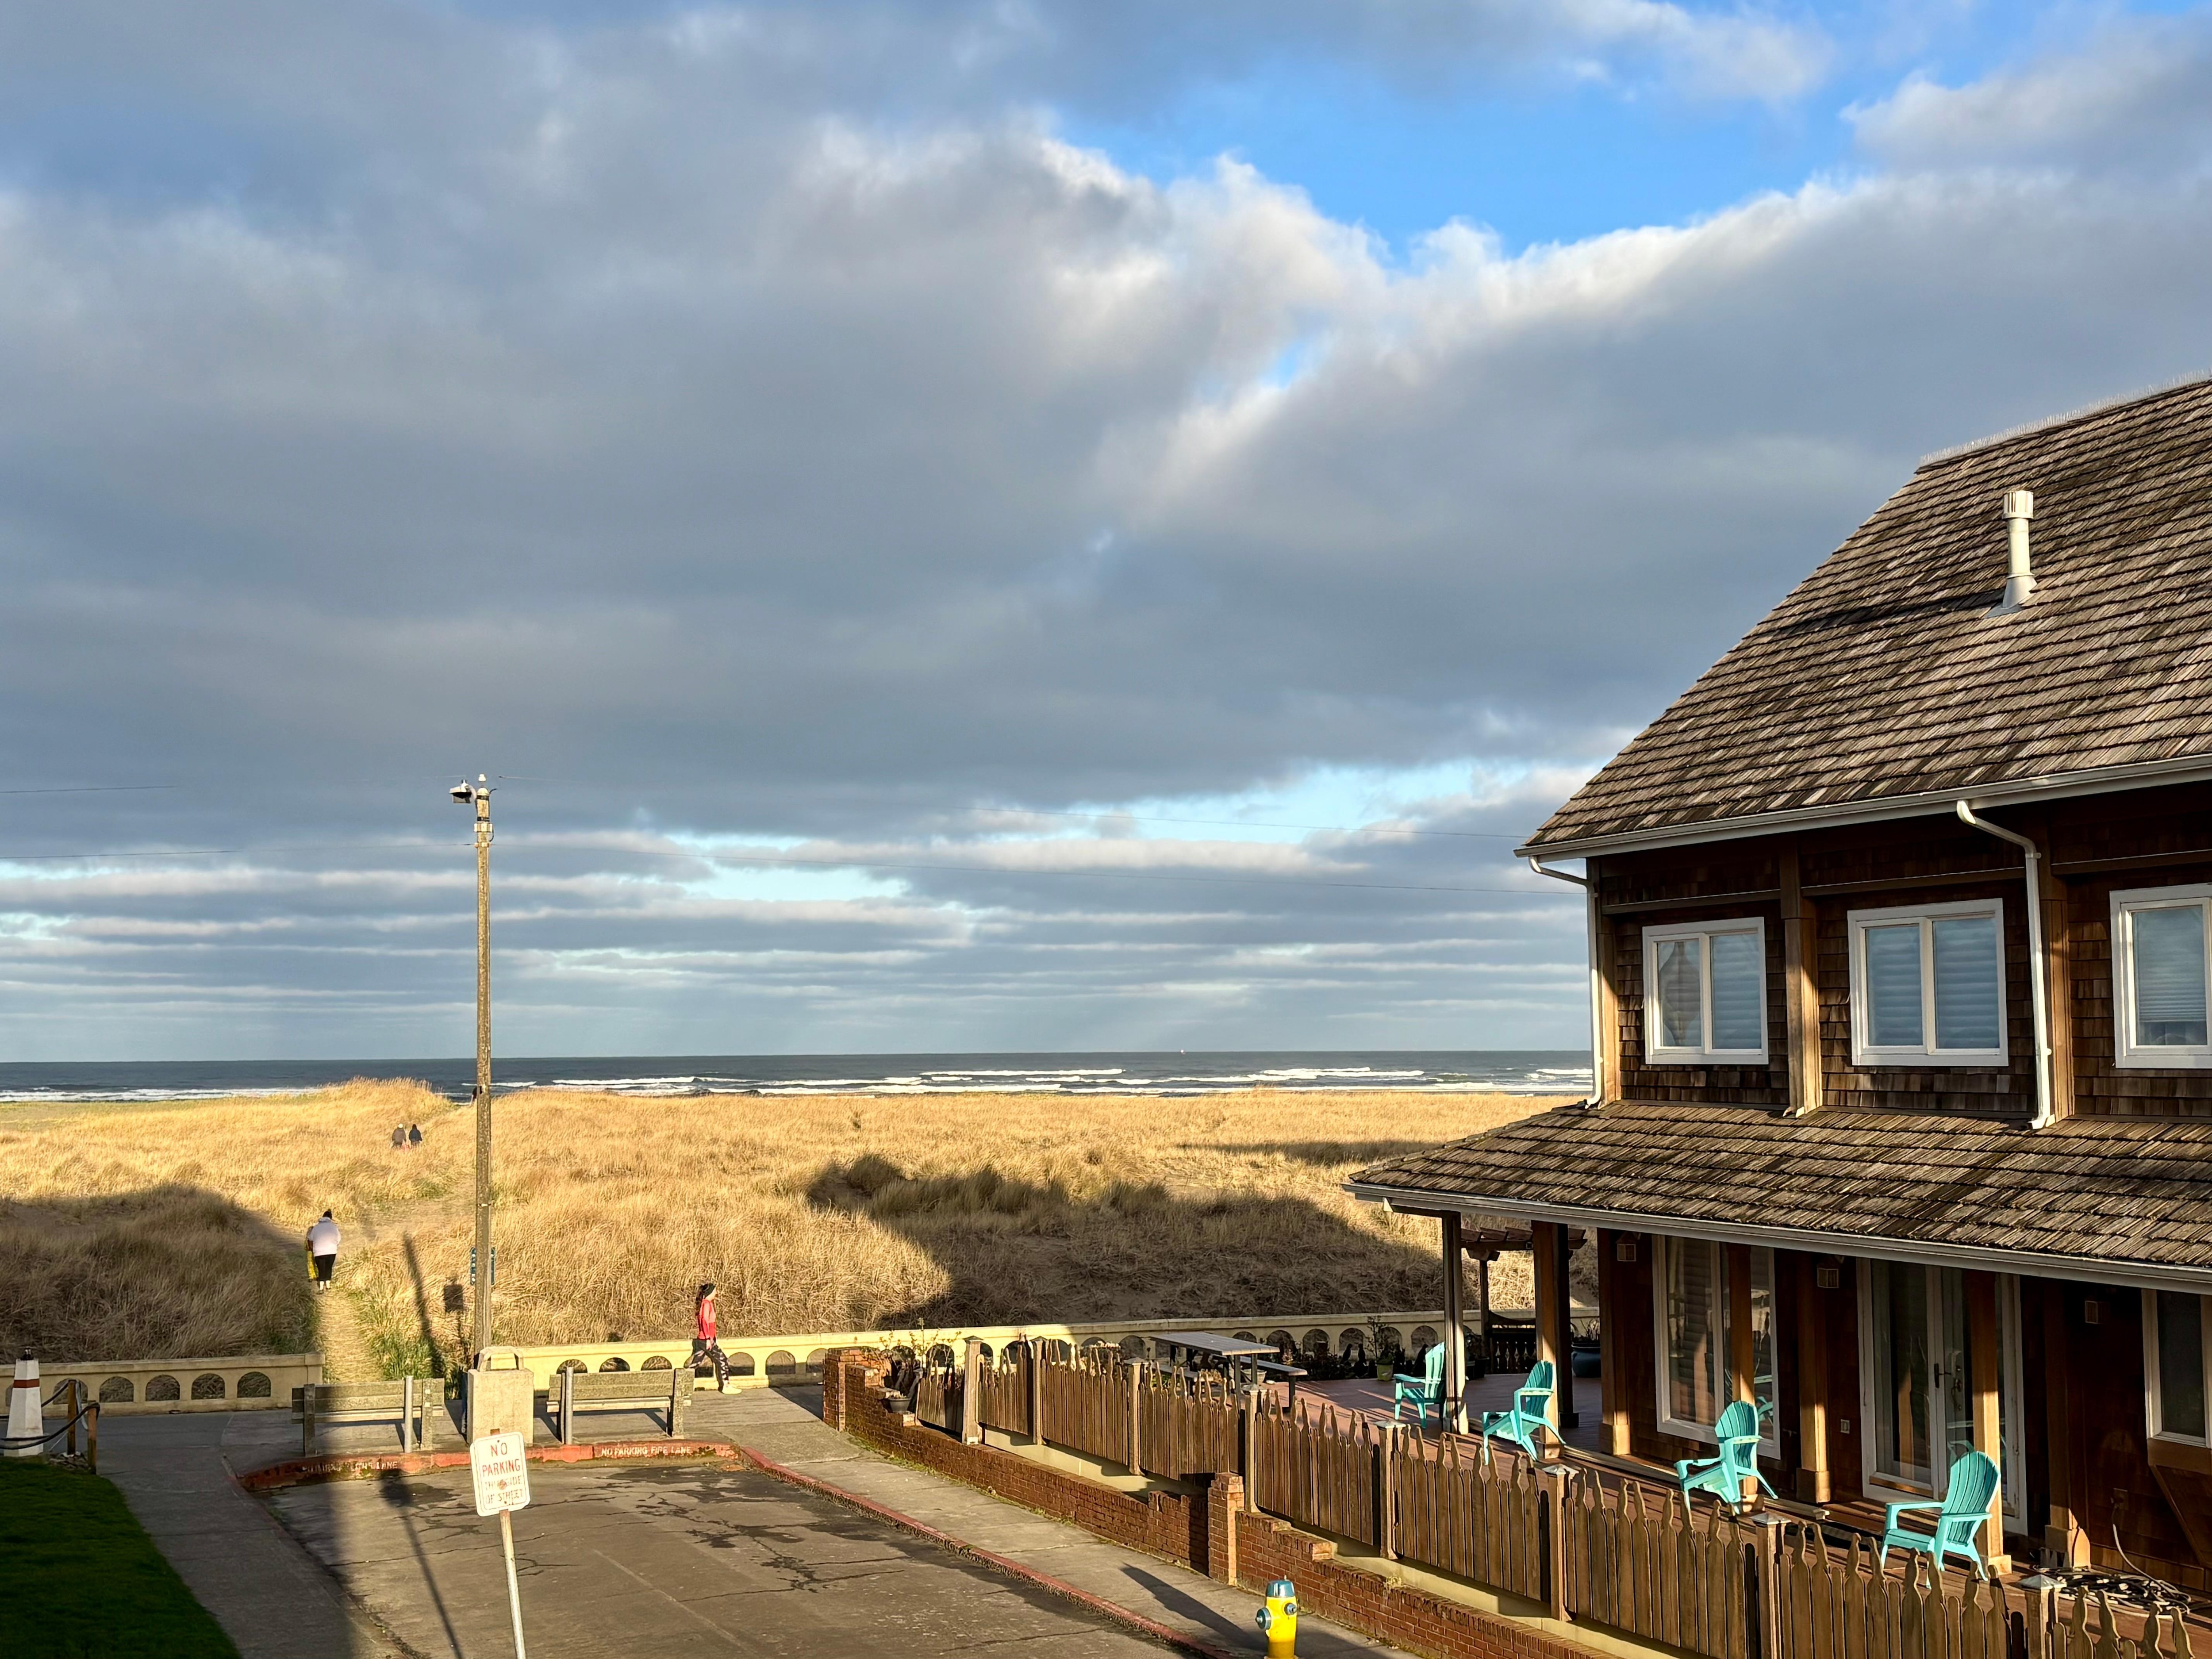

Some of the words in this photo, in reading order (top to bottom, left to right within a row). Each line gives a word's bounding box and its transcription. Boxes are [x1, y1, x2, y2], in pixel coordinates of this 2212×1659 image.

[491, 1442, 507, 1457] NO
[601, 1448, 613, 1456] NO
[614, 1446, 648, 1456] PARKING
[482, 1459, 520, 1477] PARKING
